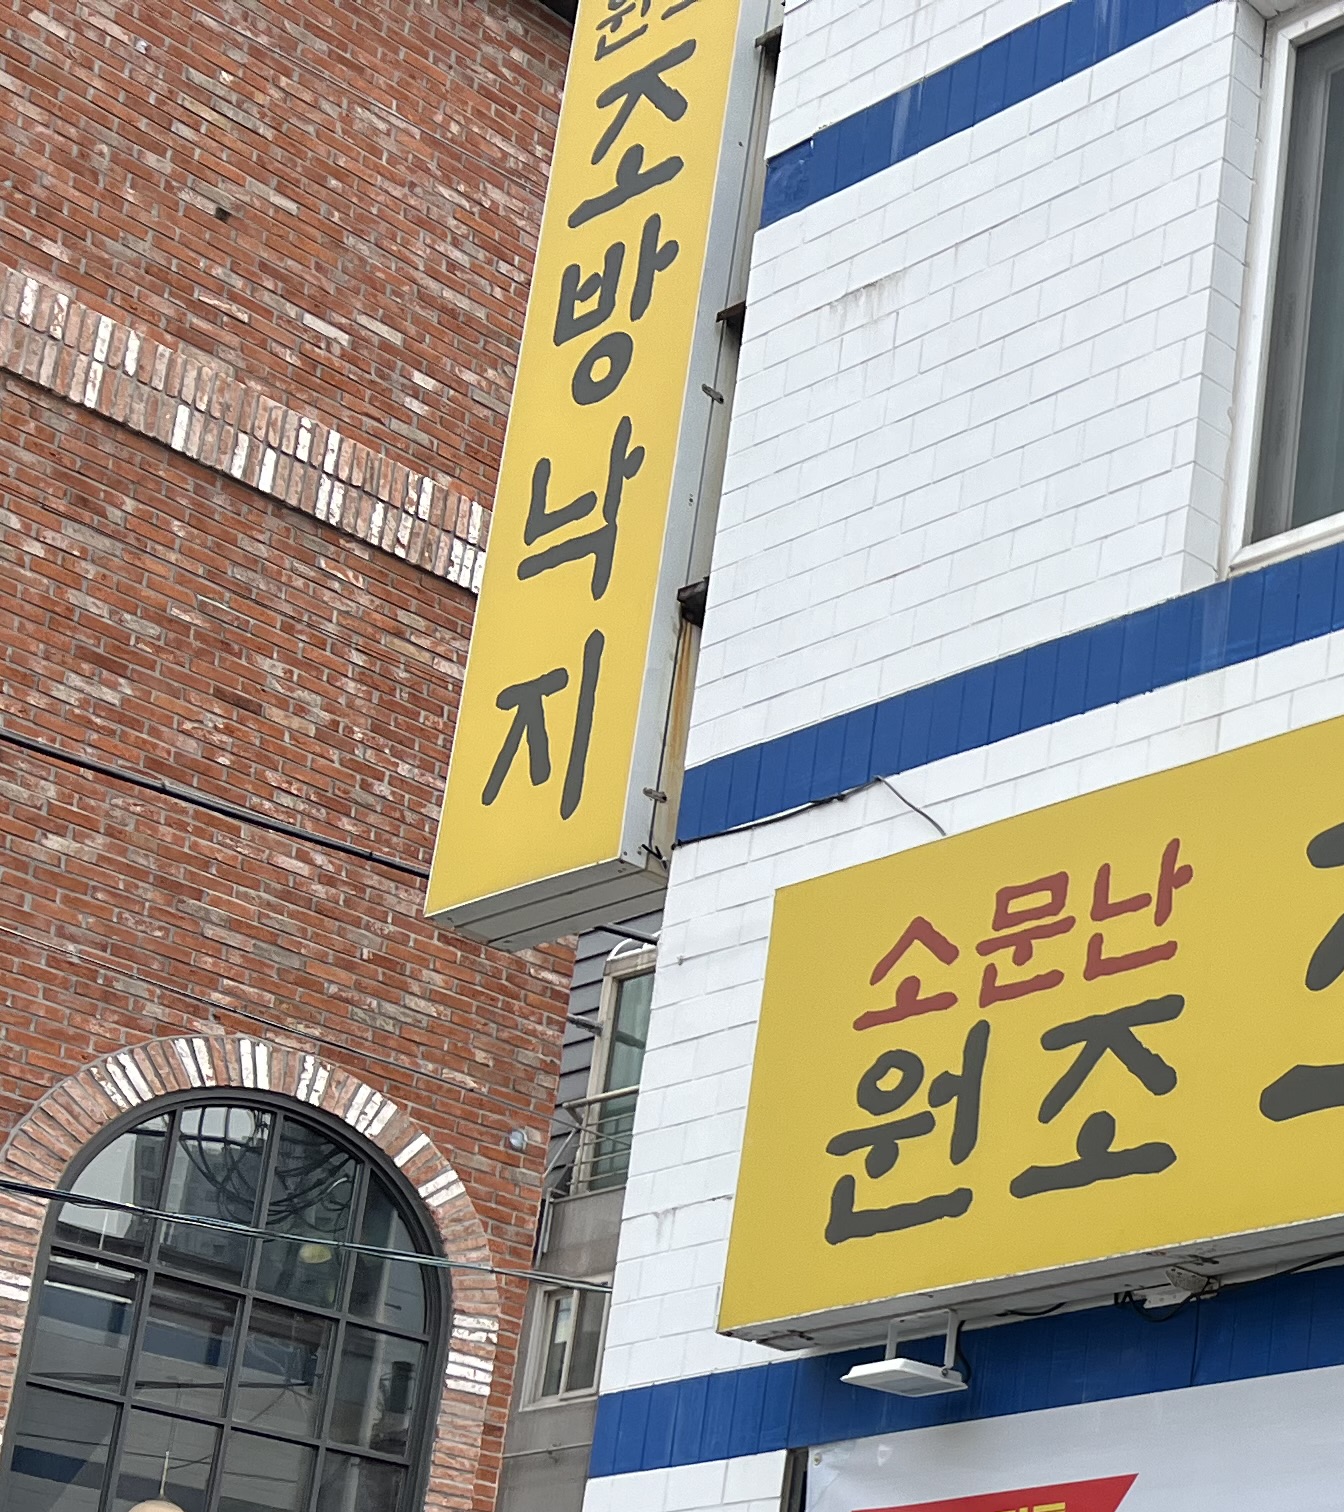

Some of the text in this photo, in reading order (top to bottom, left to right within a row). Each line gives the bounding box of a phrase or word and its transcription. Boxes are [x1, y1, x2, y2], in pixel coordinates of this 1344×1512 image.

[482, 38, 697, 821] 조방낙지
[852, 838, 1193, 1031] 소문난
[824, 994, 1185, 1246] 원조
